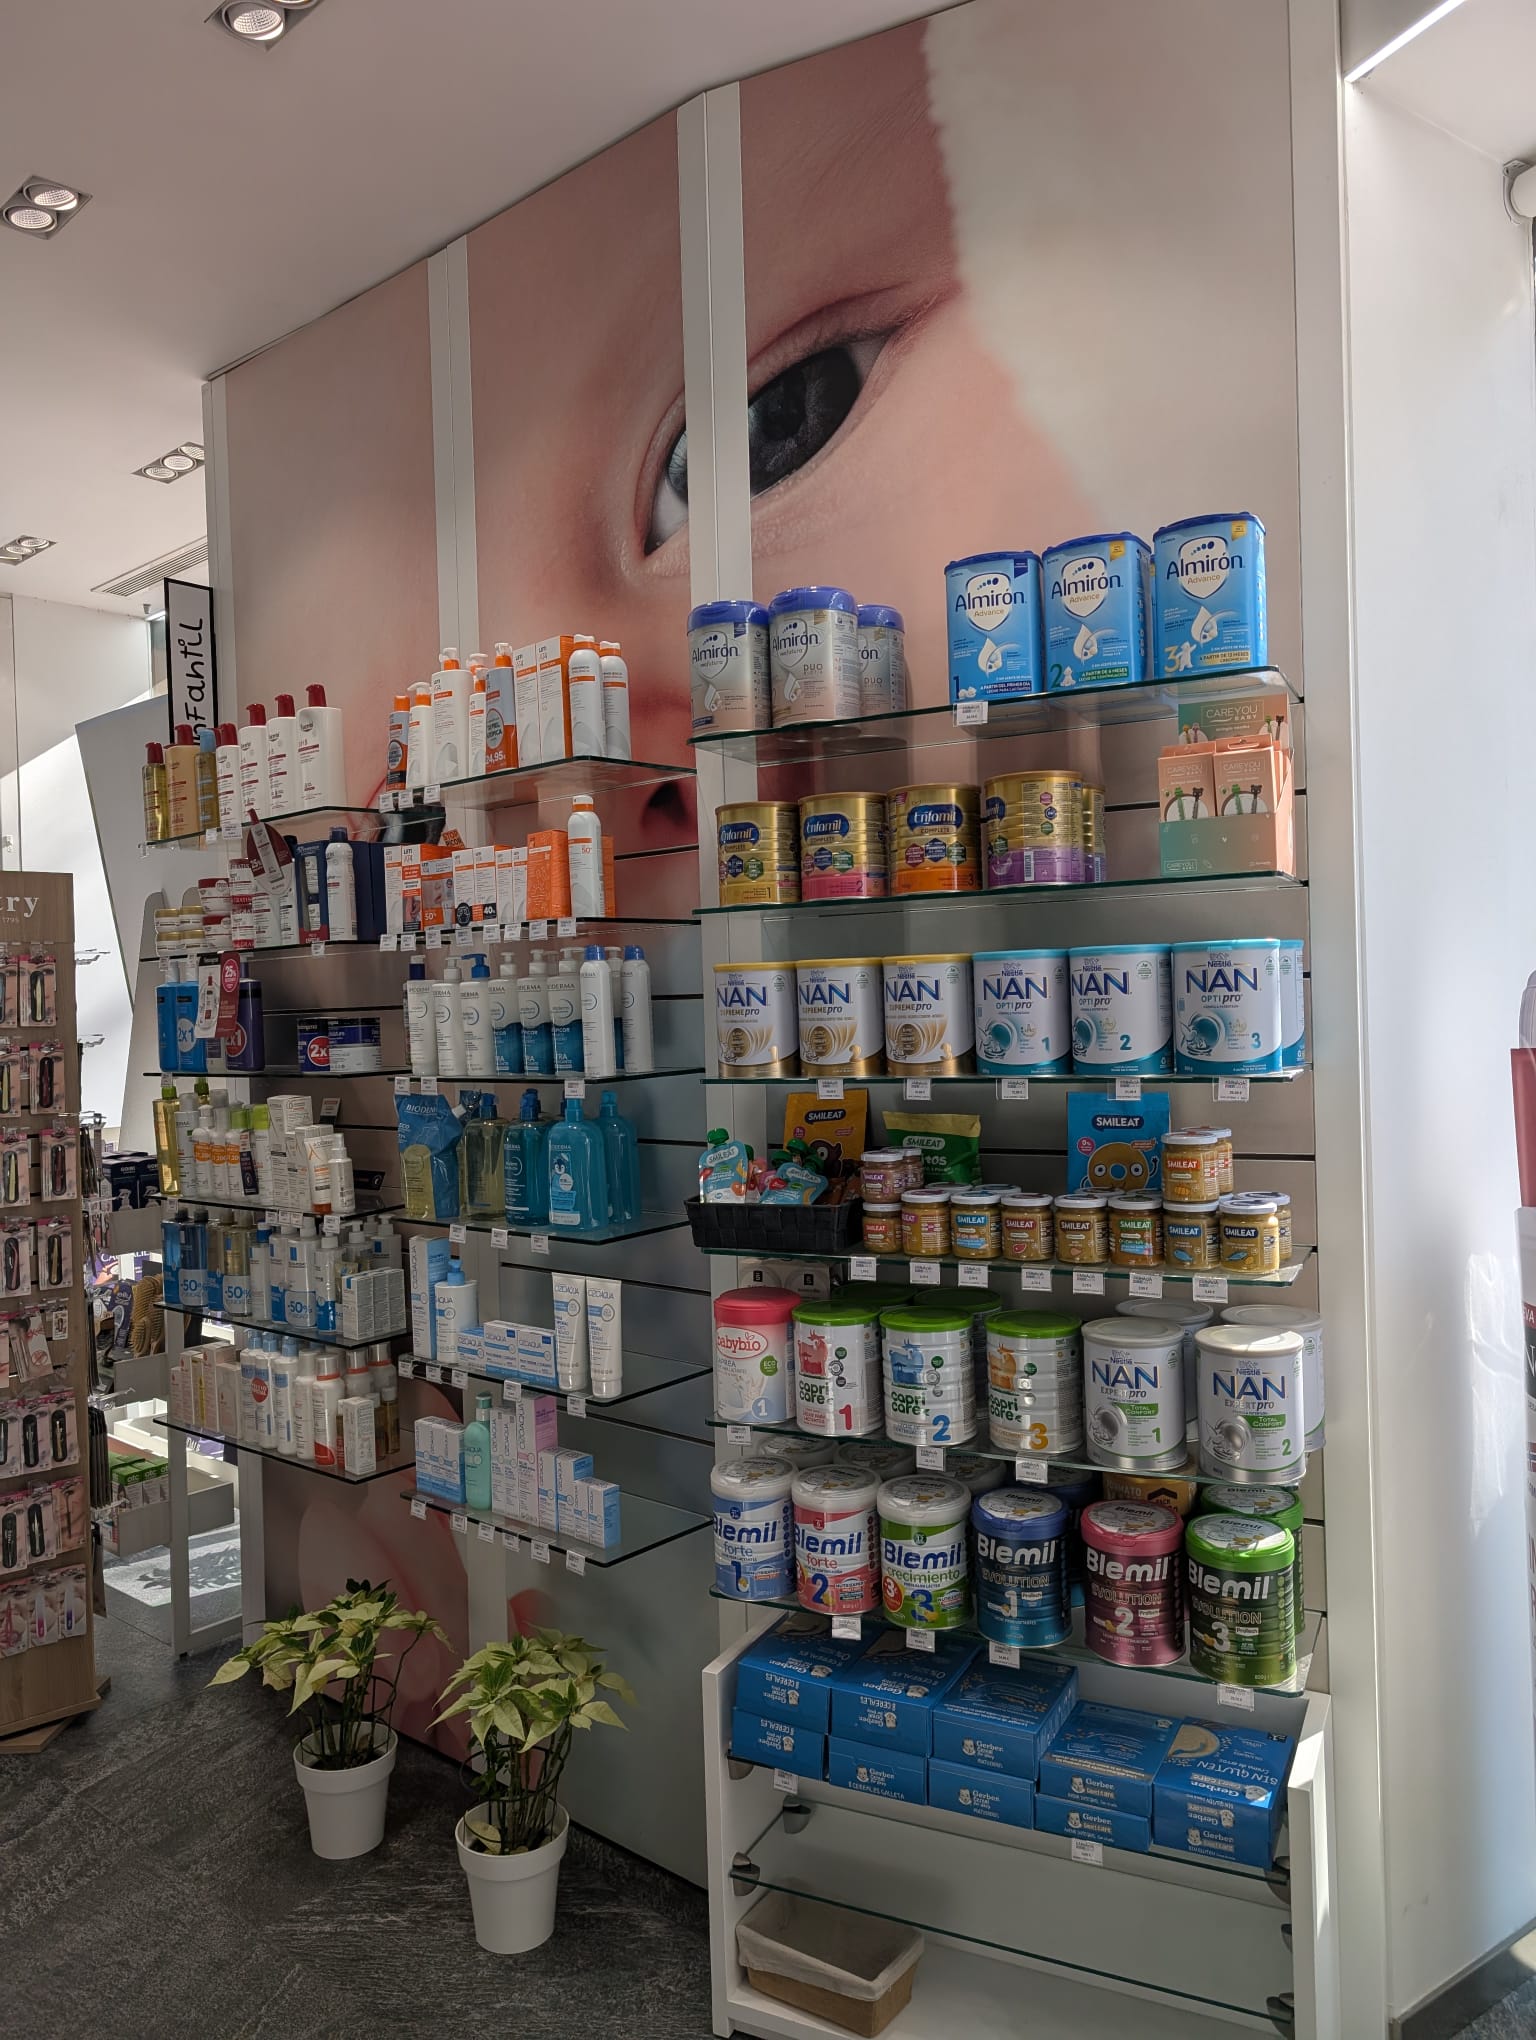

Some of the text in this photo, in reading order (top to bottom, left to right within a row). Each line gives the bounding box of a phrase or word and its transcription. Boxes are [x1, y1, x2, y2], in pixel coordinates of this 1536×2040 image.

[1166, 553, 1242, 580] Almirón
[1052, 572, 1122, 599] Almirón
[1187, 574, 1220, 585] Advance
[955, 588, 1025, 612] Almirón
[1069, 594, 1100, 604] Advance
[974, 608, 1004, 617] Advance
[772, 629, 819, 651] Almirón
[692, 643, 738, 665] Almirón
[1164, 646, 1180, 673] 3
[803, 662, 824, 673] DUO
[863, 676, 883, 686] DUO
[1050, 664, 1062, 688] 2
[953, 676, 960, 700] 1
[1206, 704, 1258, 719] CAREYOU
[914, 810, 957, 825] Enfamil
[806, 819, 842, 834] Enfamil
[920, 826, 950, 834] COMPLETE
[442, 831, 459, 840] STOP
[856, 880, 864, 892] 2
[1207, 960, 1232, 968] Nestlé
[983, 976, 1048, 1000] NAN
[1072, 972, 1128, 996] NAN
[1186, 968, 1258, 994] NAN
[718, 986, 766, 1007] NAN
[800, 983, 850, 1005] NAN
[886, 979, 940, 1002] NAN
[1042, 1037, 1050, 1052] 1
[1120, 1034, 1132, 1051] 2
[1252, 1032, 1262, 1049] 3
[808, 1111, 844, 1122] SMILEAT
[1096, 1117, 1140, 1128] SMILEAT
[906, 1138, 943, 1148] SMILEAT
[708, 1148, 736, 1164] SMILEAT
[1167, 1161, 1198, 1169] SMILEAT
[864, 1173, 884, 1182] SMILEAT
[956, 1216, 987, 1224] SMILEAT
[1005, 1220, 1034, 1228] SMILEAT
[1060, 1222, 1090, 1230] SMILEAT
[1120, 1221, 1151, 1230] SMILEAT
[1169, 1227, 1199, 1236] SMILEAT
[1225, 1229, 1256, 1238] SMILEAT
[224, 1282, 252, 1299] -50%
[287, 1298, 313, 1313] -50%
[716, 1336, 760, 1353] babybio
[1110, 1356, 1134, 1365] Nestlé
[1091, 1360, 1158, 1389] NAN
[1236, 1368, 1260, 1376] Nestlé
[800, 1380, 830, 1398] capri
[1213, 1370, 1286, 1402] NAN
[800, 1392, 825, 1406] care
[891, 1391, 926, 1410] capri
[989, 1394, 1019, 1414] capri
[758, 1401, 768, 1416] 1
[892, 1402, 922, 1416] care
[990, 1405, 1014, 1422] care
[1126, 1408, 1156, 1416] CONFORT
[838, 1404, 852, 1431] 1
[1252, 1420, 1282, 1428] CONFORT
[932, 1414, 952, 1442] 2
[1152, 1427, 1161, 1444] 1
[1028, 1423, 1049, 1450] 3
[1282, 1438, 1292, 1456] 2
[724, 1543, 754, 1556] forte
[885, 1540, 962, 1570] Blemil
[977, 1532, 1055, 1566] Blemil
[806, 1556, 838, 1569] forte
[1086, 1548, 1170, 1582] Blemil
[888, 1566, 960, 1581] crecimiento
[811, 1573, 830, 1604] 2
[1188, 1563, 1271, 1600] Blemil
[1092, 1582, 1162, 1604] EVOLUTION
[910, 1590, 938, 1622] 3
[1004, 1590, 1018, 1618] 1
[1194, 1598, 1262, 1624] EVOLUTION
[1115, 1608, 1134, 1637] 2
[1211, 1622, 1231, 1651] 3
[768, 1660, 807, 1674] Gerber
[766, 1674, 795, 1689] CEREALES
[865, 1682, 903, 1695] Gerber
[860, 1696, 892, 1710] CEREALES
[761, 1719, 790, 1734] CEREALES
[976, 1740, 1003, 1752] Gerber
[869, 1768, 894, 1780] Gerber
[1196, 1760, 1278, 1786] SIN GLUTEN
[1085, 1778, 1115, 1790] Gerber
[1190, 1780, 1240, 1798] Gerber
[973, 1790, 1000, 1802] Gerber
[1082, 1812, 1111, 1826] Gerber
[1188, 1812, 1218, 1826] Gerber
[1203, 1830, 1234, 1843] Gerber
